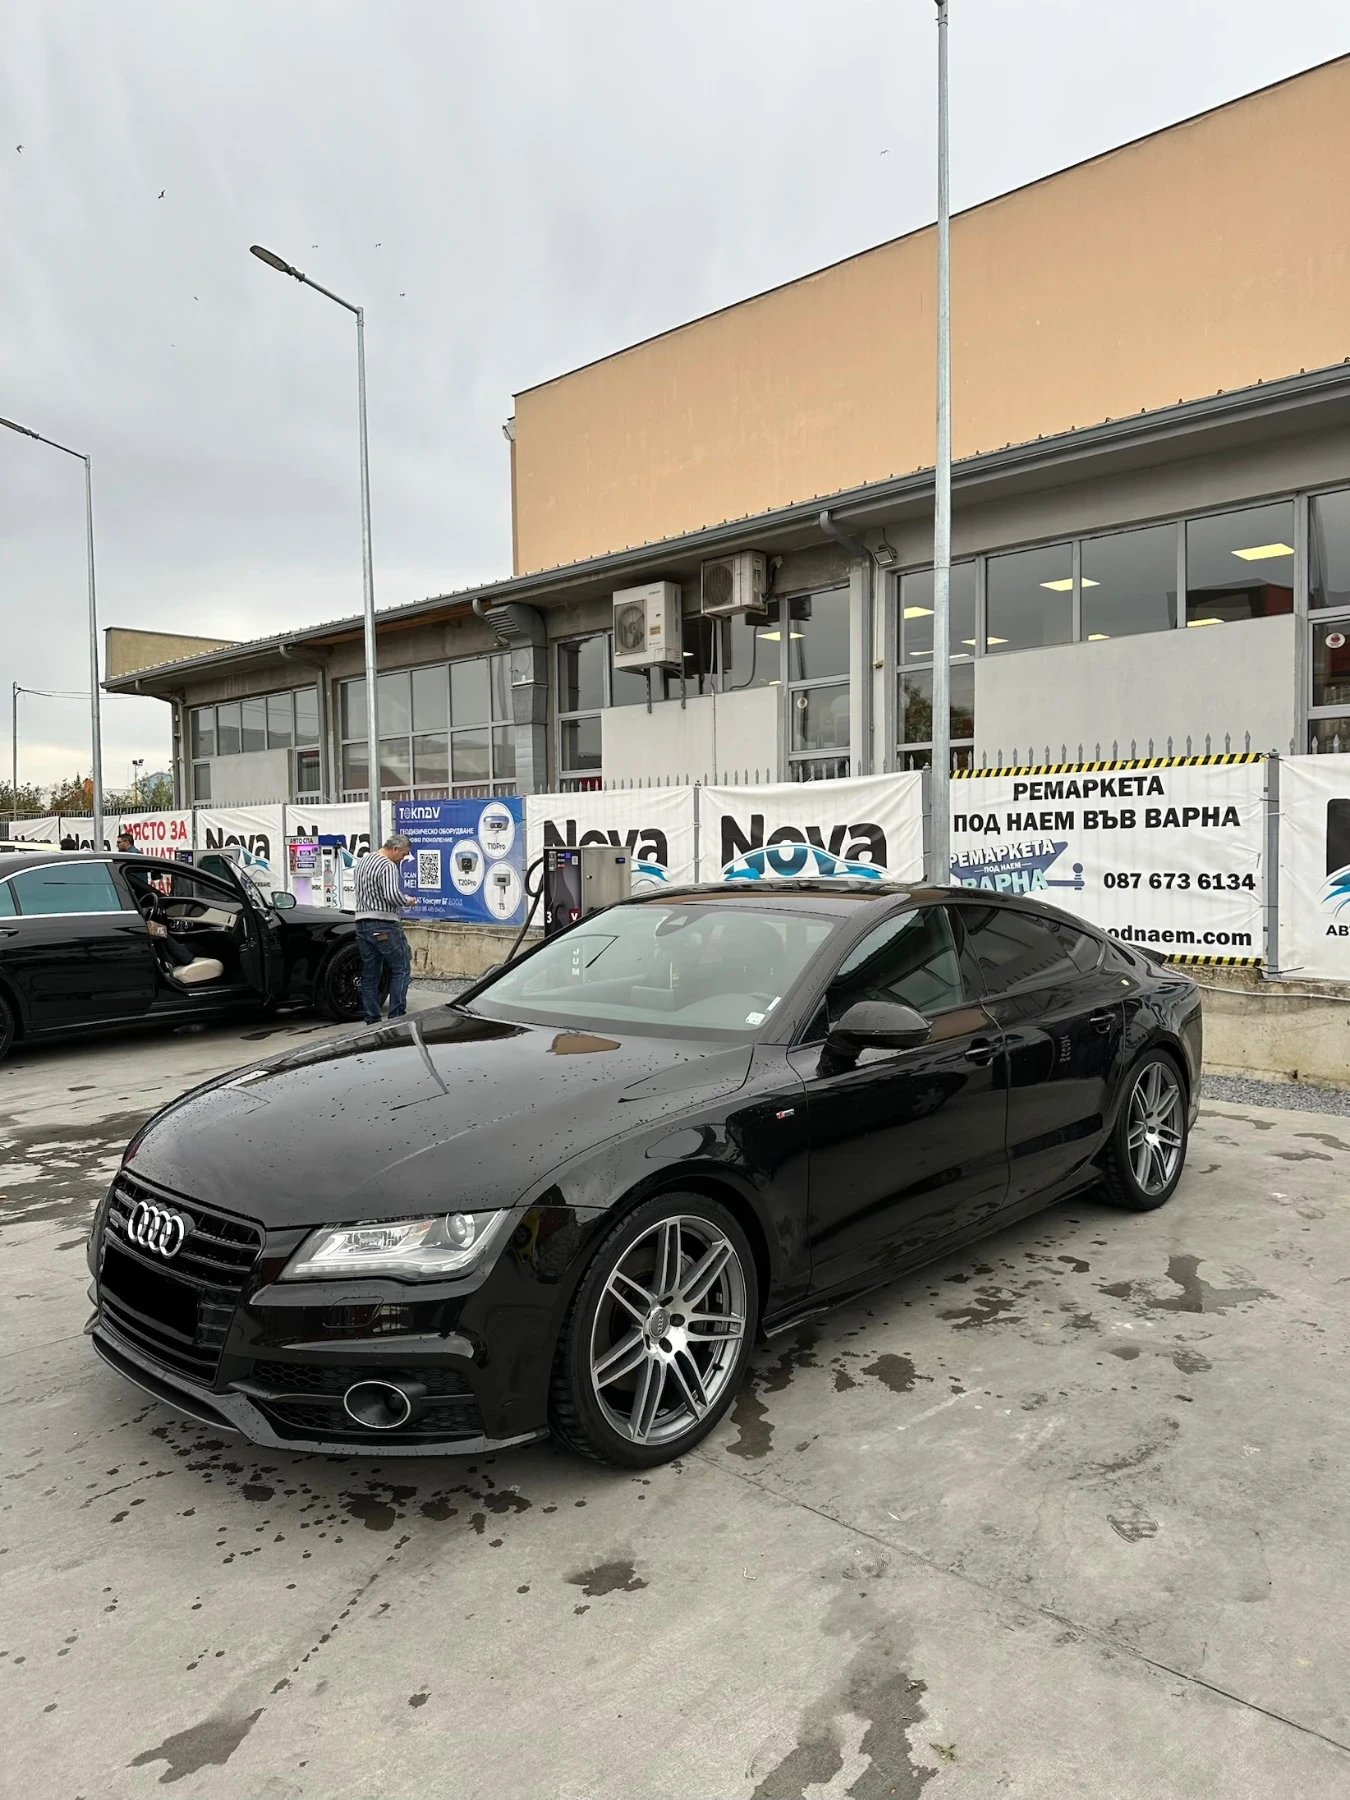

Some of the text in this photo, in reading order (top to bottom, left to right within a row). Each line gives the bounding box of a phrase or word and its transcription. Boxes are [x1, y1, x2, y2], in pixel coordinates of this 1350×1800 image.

[1013, 775, 1164, 801] РЕМАРКЕТА
[954, 806, 1241, 835] ПОД НАЕМ ВЪВ ВАРНА
[170, 820, 188, 840] ЗА
[439, 827, 474, 836] ОБОРУДВАНЕ
[487, 842, 506, 850] T10Pro
[721, 813, 887, 877] Nova
[983, 861, 1022, 873] ПОД НАЕМ
[404, 879, 417, 888] ME!
[457, 879, 477, 887] T20Pro
[1104, 872, 1256, 891] 087 673 6134
[546, 911, 553, 924] 3
[1101, 924, 1253, 946] odnaem.com
